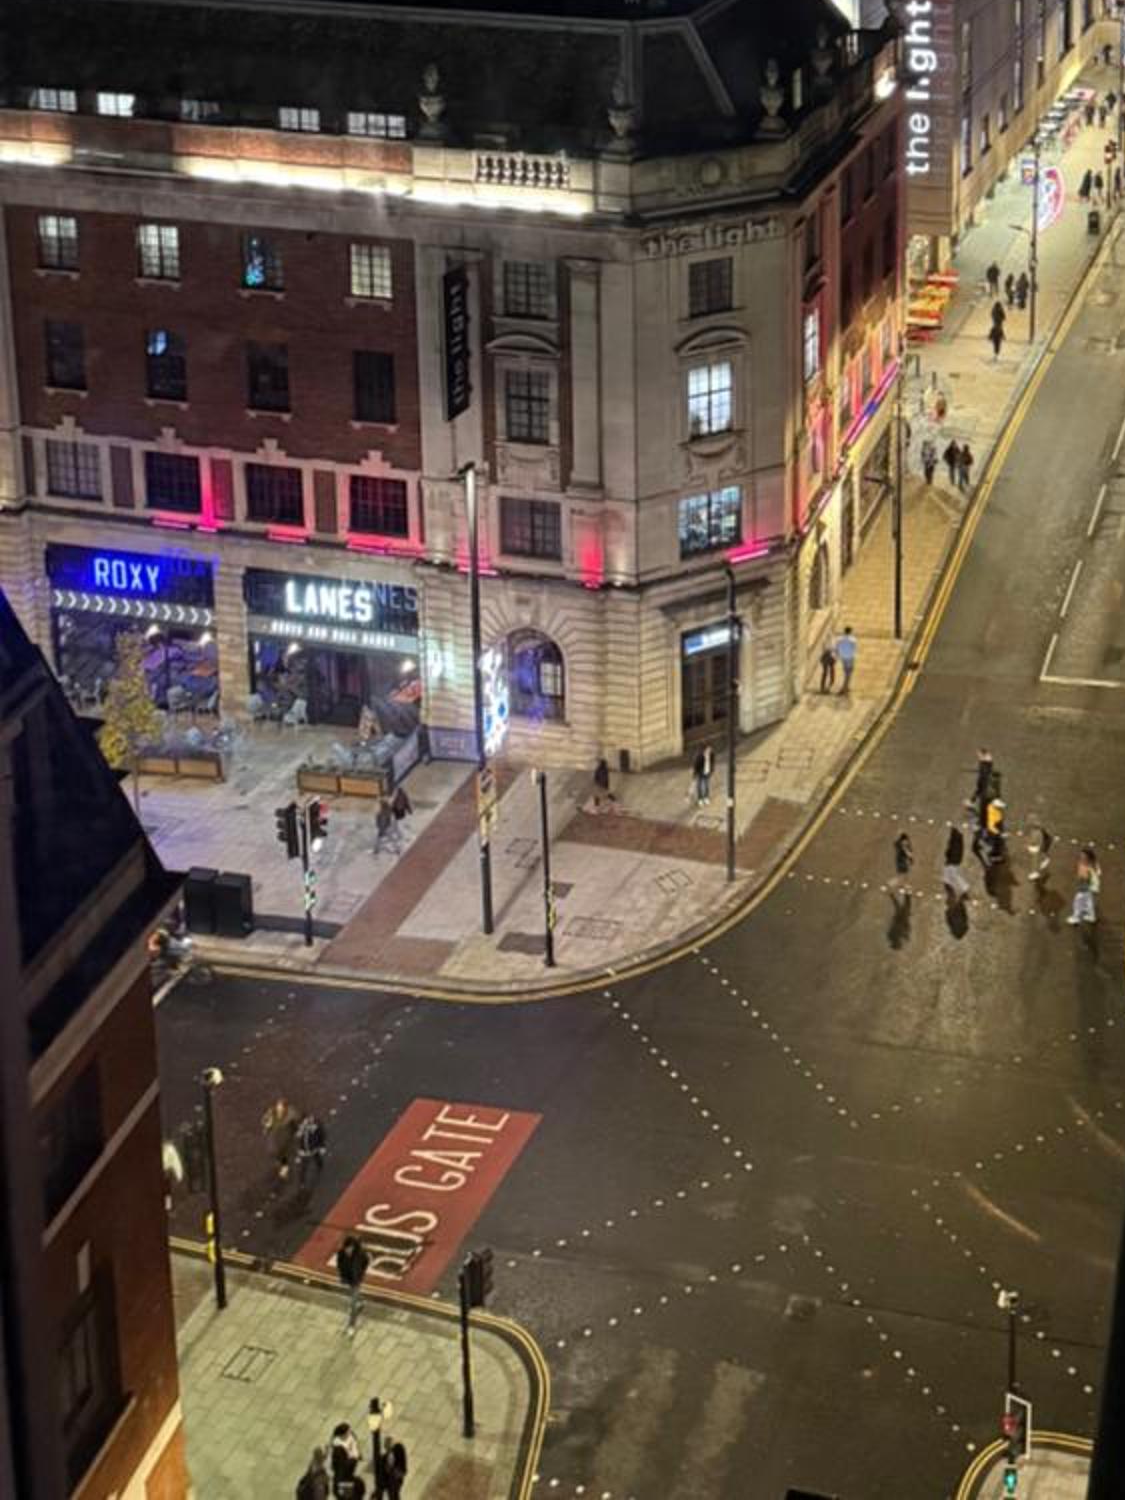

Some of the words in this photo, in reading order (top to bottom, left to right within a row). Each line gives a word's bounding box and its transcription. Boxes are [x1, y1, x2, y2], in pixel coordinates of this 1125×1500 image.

[905, 112, 930, 176] the
[450, 283, 465, 355] light
[451, 359, 465, 404] the
[93, 557, 160, 593] ROXY
[285, 578, 373, 622] LANES
[394, 1103, 510, 1191] GATE
